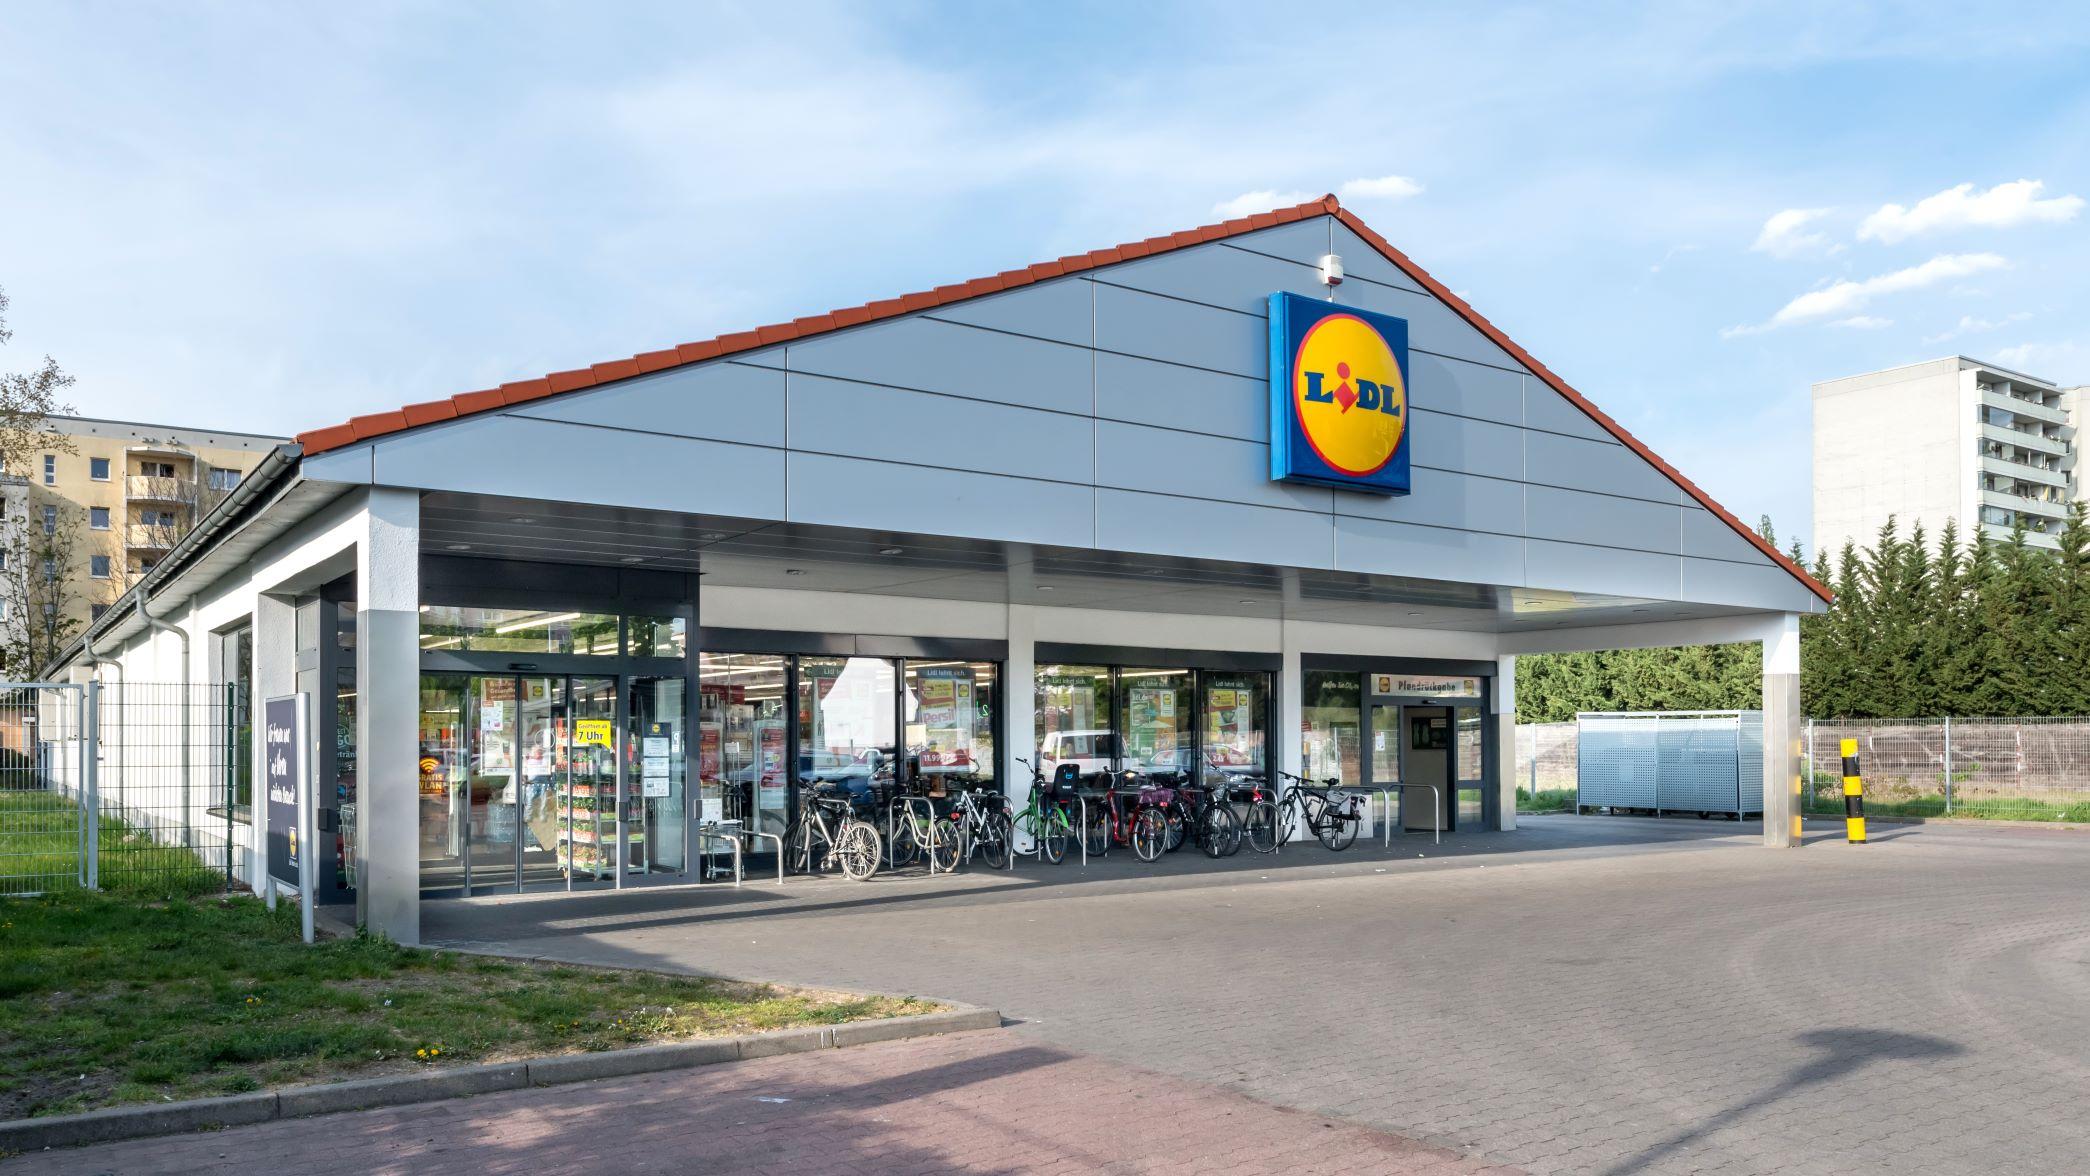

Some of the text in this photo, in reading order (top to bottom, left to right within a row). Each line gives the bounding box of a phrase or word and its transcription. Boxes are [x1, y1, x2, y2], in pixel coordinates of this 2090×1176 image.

[1398, 680, 1456, 694] Pfandrückgabe
[578, 731, 603, 741] 7 Uhr
